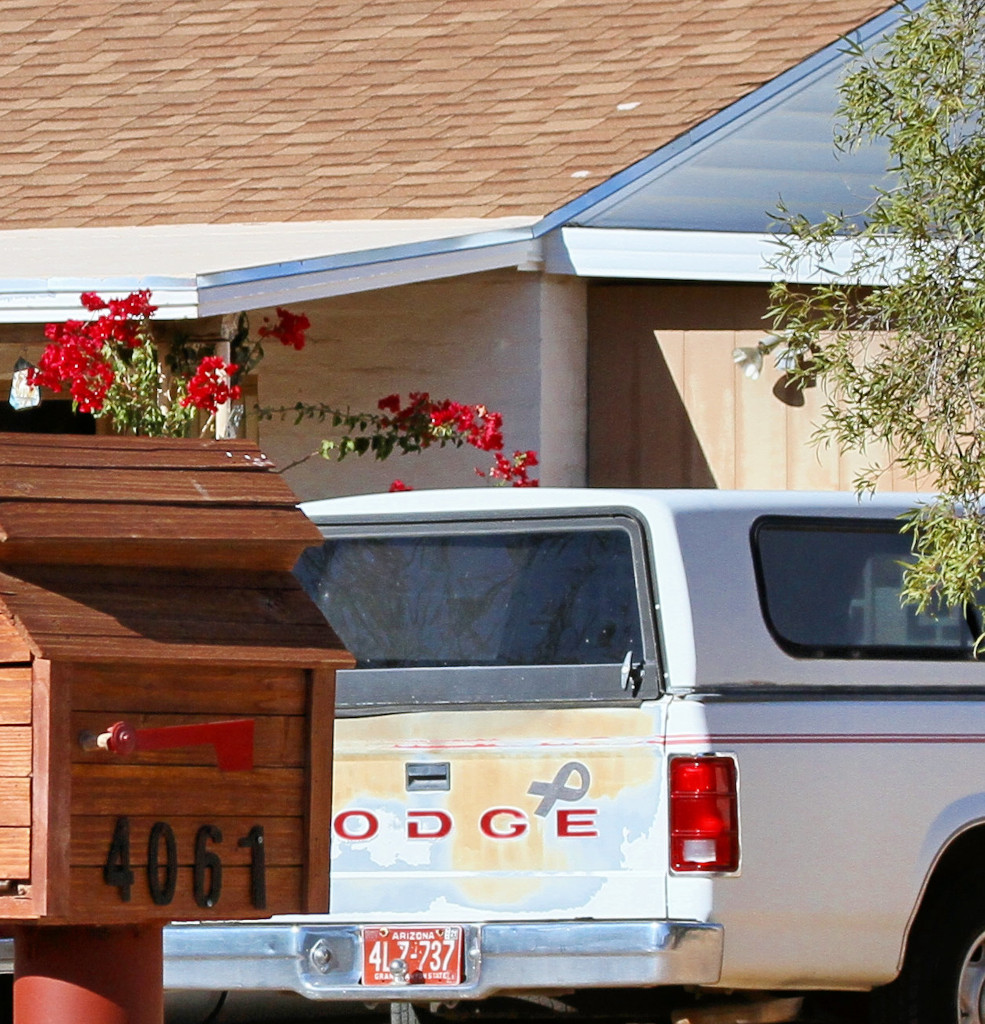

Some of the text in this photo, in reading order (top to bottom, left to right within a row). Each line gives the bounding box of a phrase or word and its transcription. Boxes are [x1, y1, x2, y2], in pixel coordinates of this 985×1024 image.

[333, 808, 599, 839] ODGE
[103, 816, 266, 910] 4061
[392, 931, 435, 940] ARIZONA
[374, 972, 394, 980] GRAN
